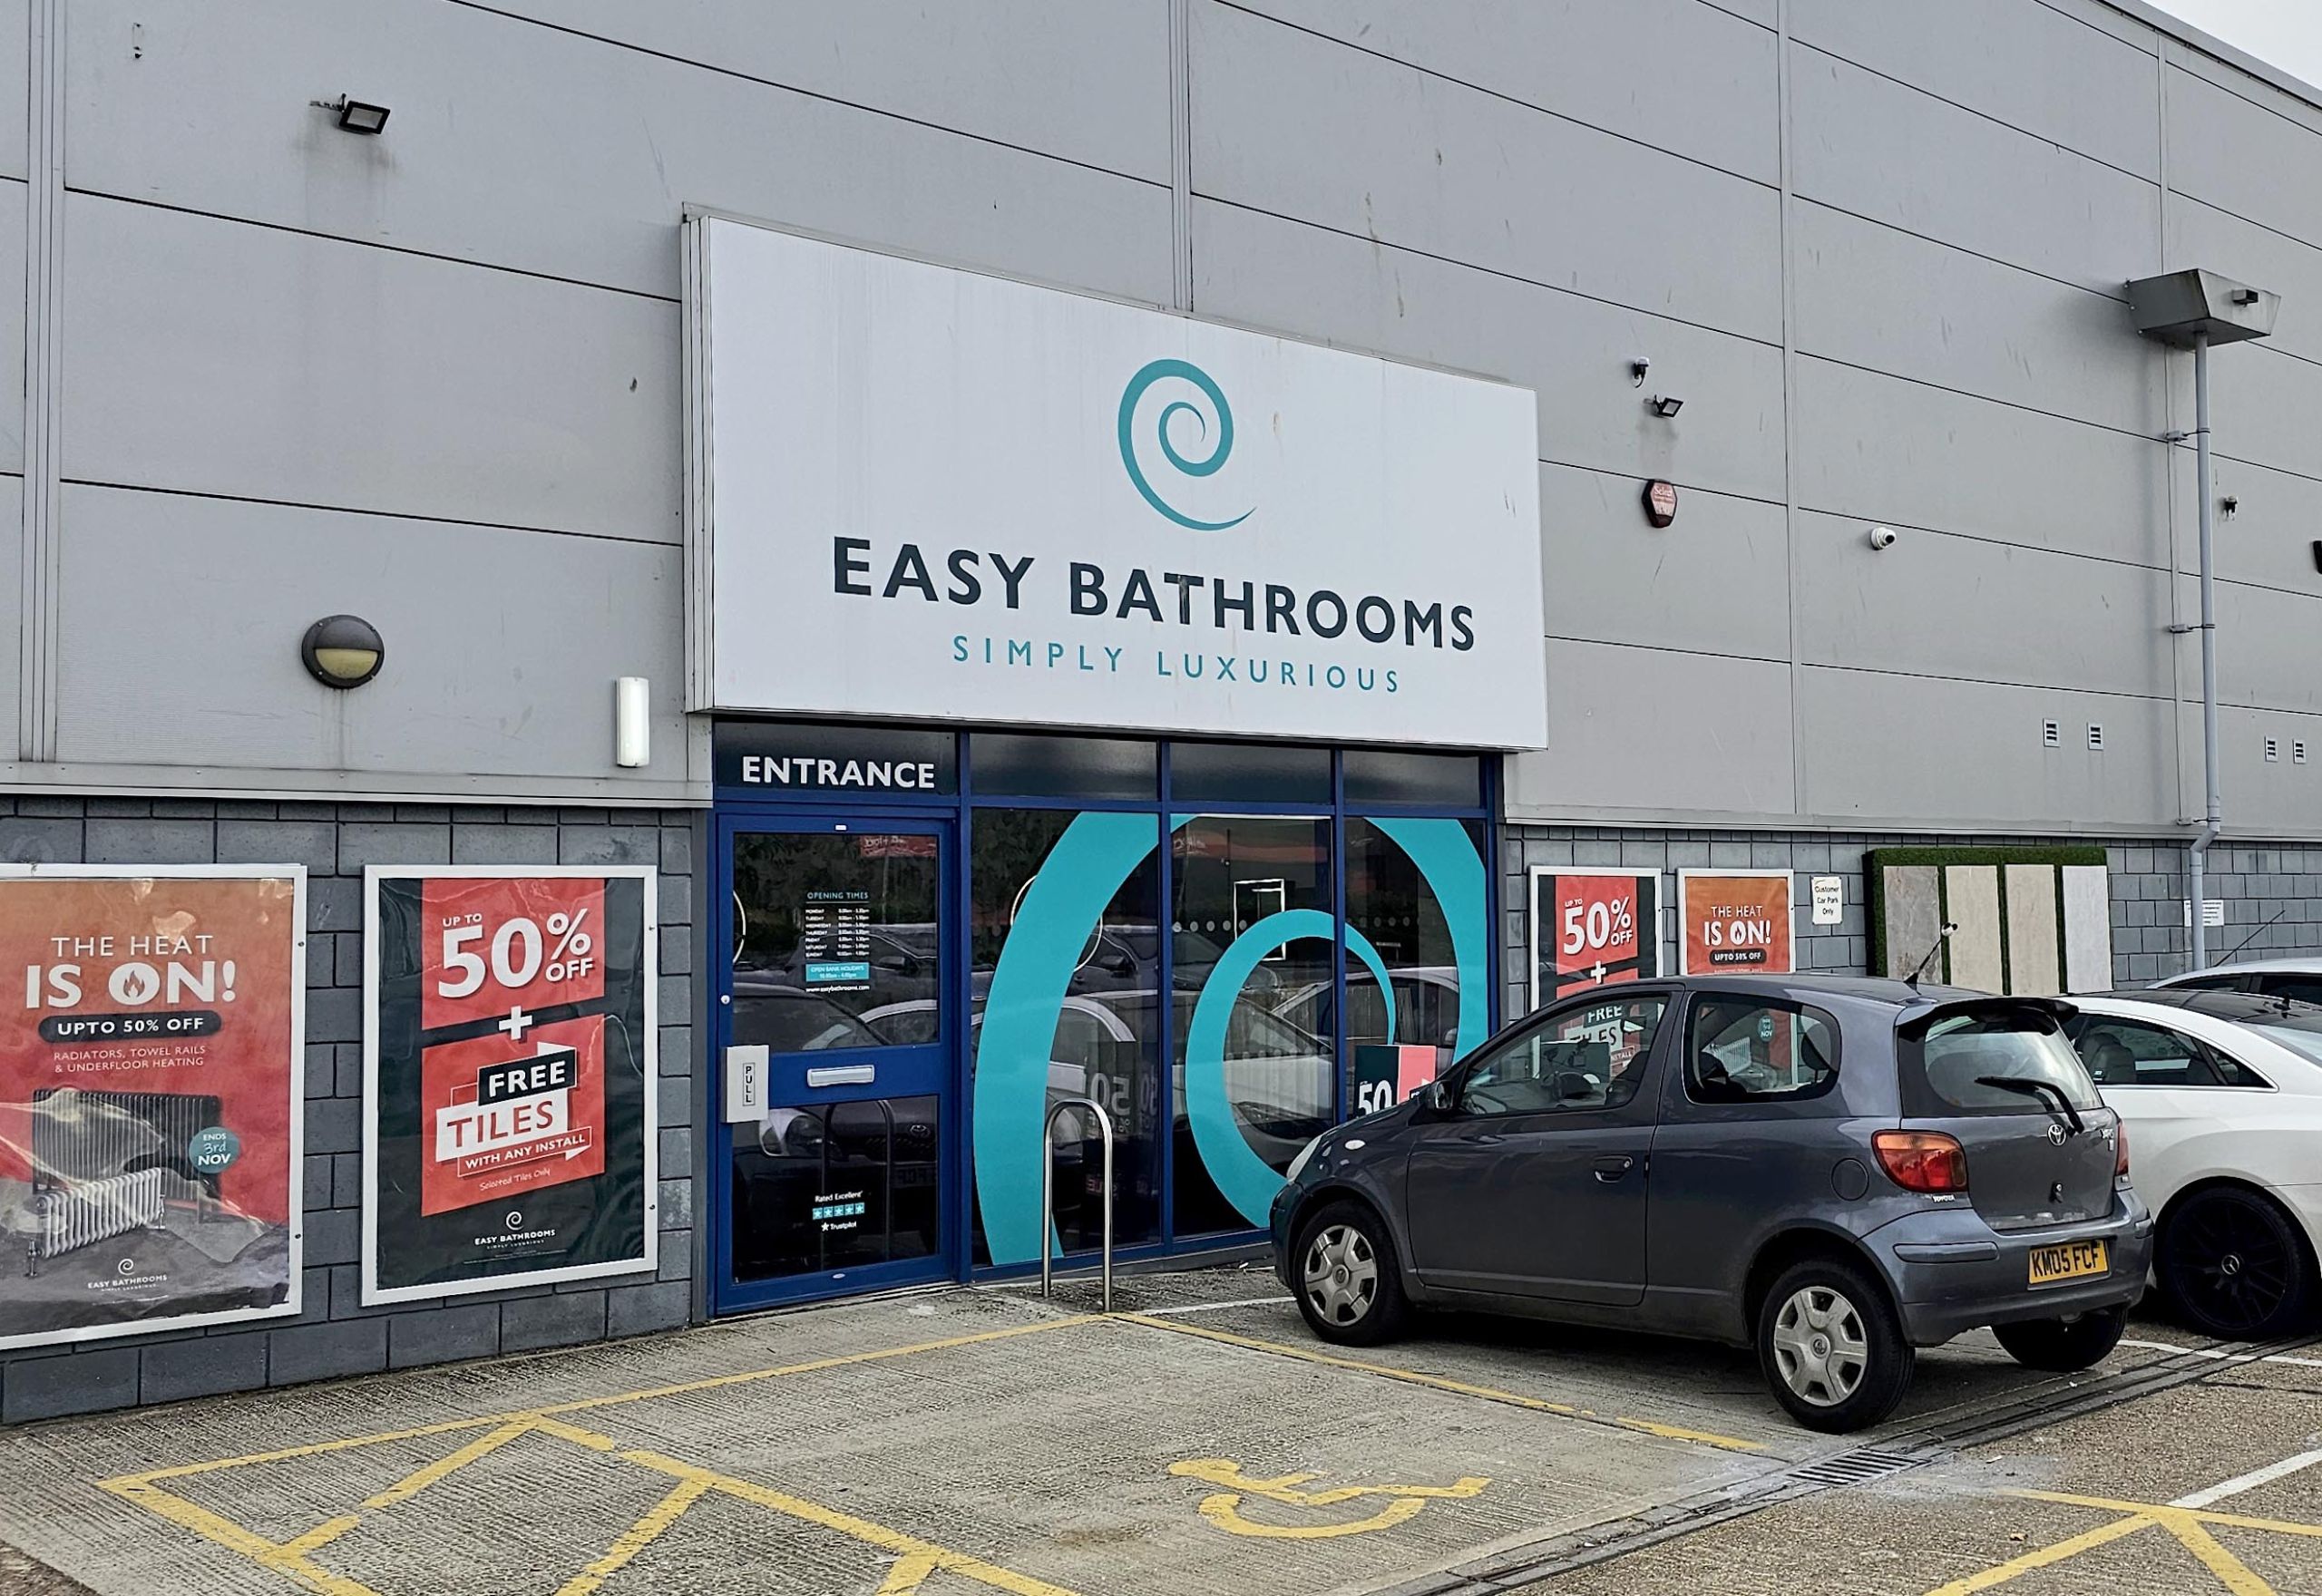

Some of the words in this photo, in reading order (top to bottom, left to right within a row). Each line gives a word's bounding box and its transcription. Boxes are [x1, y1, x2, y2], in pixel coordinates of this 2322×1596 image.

[834, 536, 1035, 610] EASY
[1069, 562, 1475, 650] BATHROOMS
[953, 635, 1122, 673] SIMPLY
[1158, 650, 1400, 693] LUXURIOUS
[743, 755, 935, 789] ENTRANCE
[806, 891, 844, 900] OPENING
[846, 891, 869, 900] TIMES
[1575, 898, 1583, 906] TO
[443, 916, 460, 927] UP
[464, 913, 482, 924] TO
[1711, 906, 1732, 918] THE
[1736, 905, 1763, 918] HEAT
[1822, 908, 1833, 916] Only
[1564, 896, 1631, 954] 50%
[1704, 920, 1722, 946] IS
[1730, 920, 1771, 946] ON!
[1611, 929, 1633, 945] OFF
[51, 936, 114, 957] THE
[131, 935, 214, 956] HEAT
[438, 908, 591, 998] 50%
[1735, 952, 1747, 960] 50%
[1748, 951, 1761, 959] OFF
[546, 958, 593, 982] OFF
[26, 963, 83, 1009] IS
[108, 959, 236, 1006] ON!
[1588, 1006, 1623, 1023] FREE
[57, 1021, 115, 1036] UPTO
[123, 1019, 160, 1033] 50%
[167, 1017, 204, 1031] OFF
[1761, 1030, 1772, 1038] NOV
[54, 1049, 126, 1061] RADIATORS,
[131, 1046, 171, 1057] TOWEL
[175, 1045, 206, 1055] RAILS
[54, 1064, 63, 1073] &
[67, 1059, 149, 1073] UNDERFLOOR
[152, 1056, 204, 1067] HEATING
[489, 1060, 566, 1098] FREE
[447, 1100, 553, 1148] TILES
[202, 1133, 227, 1142] ENDS
[203, 1141, 227, 1154] 3rd
[465, 1152, 501, 1169] WITH
[504, 1146, 532, 1161] ANY
[535, 1134, 585, 1153] INSTALL
[198, 1153, 231, 1166] NOV
[479, 1177, 513, 1192] Selected
[513, 1173, 533, 1182] Tiles
[533, 1168, 551, 1178] Only
[815, 1193, 834, 1202] Rated
[474, 1236, 498, 1246] EASY
[500, 1229, 556, 1242] BATHROOMS
[2032, 1248, 2071, 1278] KM05
[2073, 1241, 2101, 1270] FCF
[87, 1280, 111, 1289] EASY
[112, 1274, 168, 1286] BATHROOMS
